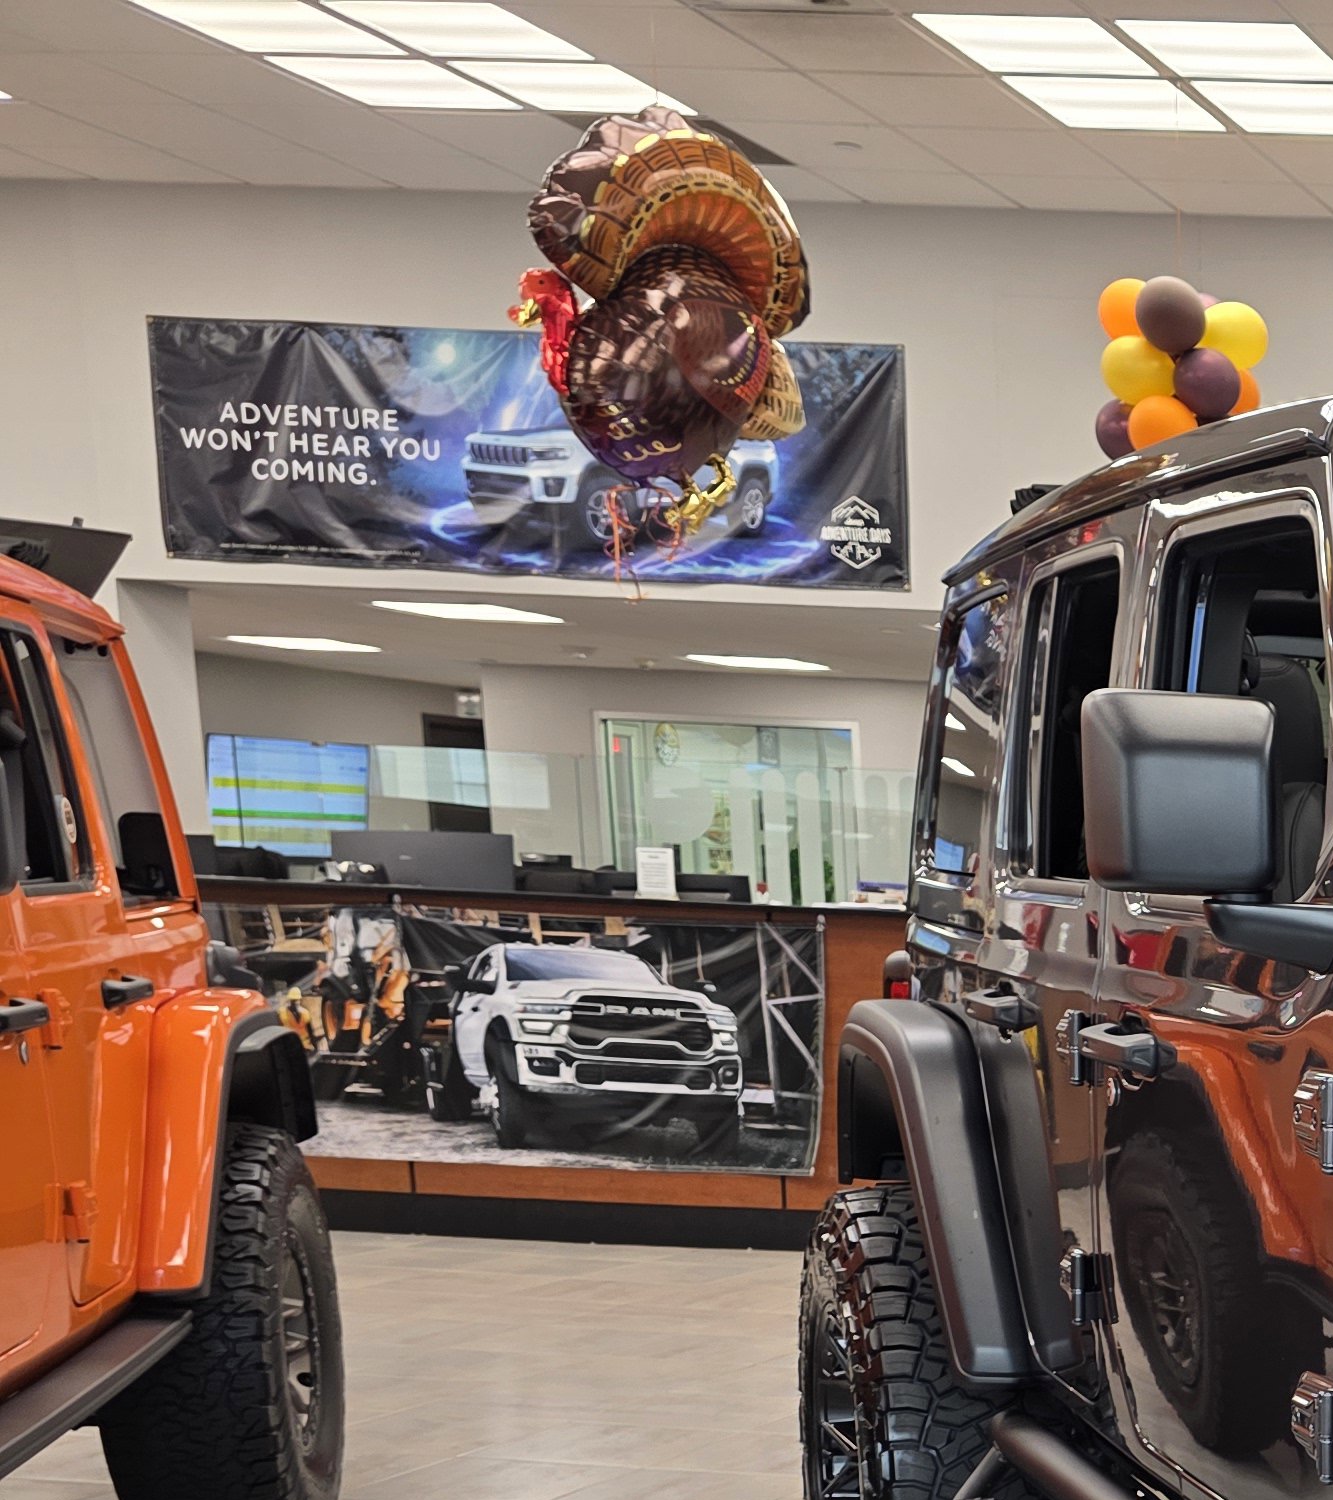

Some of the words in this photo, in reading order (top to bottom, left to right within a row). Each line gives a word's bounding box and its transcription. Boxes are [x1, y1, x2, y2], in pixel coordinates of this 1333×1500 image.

[219, 401, 400, 432] ADVENTURE
[180, 427, 279, 453] WON'T
[289, 432, 372, 458] HEAR
[380, 436, 441, 461] YOU
[251, 458, 377, 486] COMING.
[606, 1004, 675, 1017] RAM
